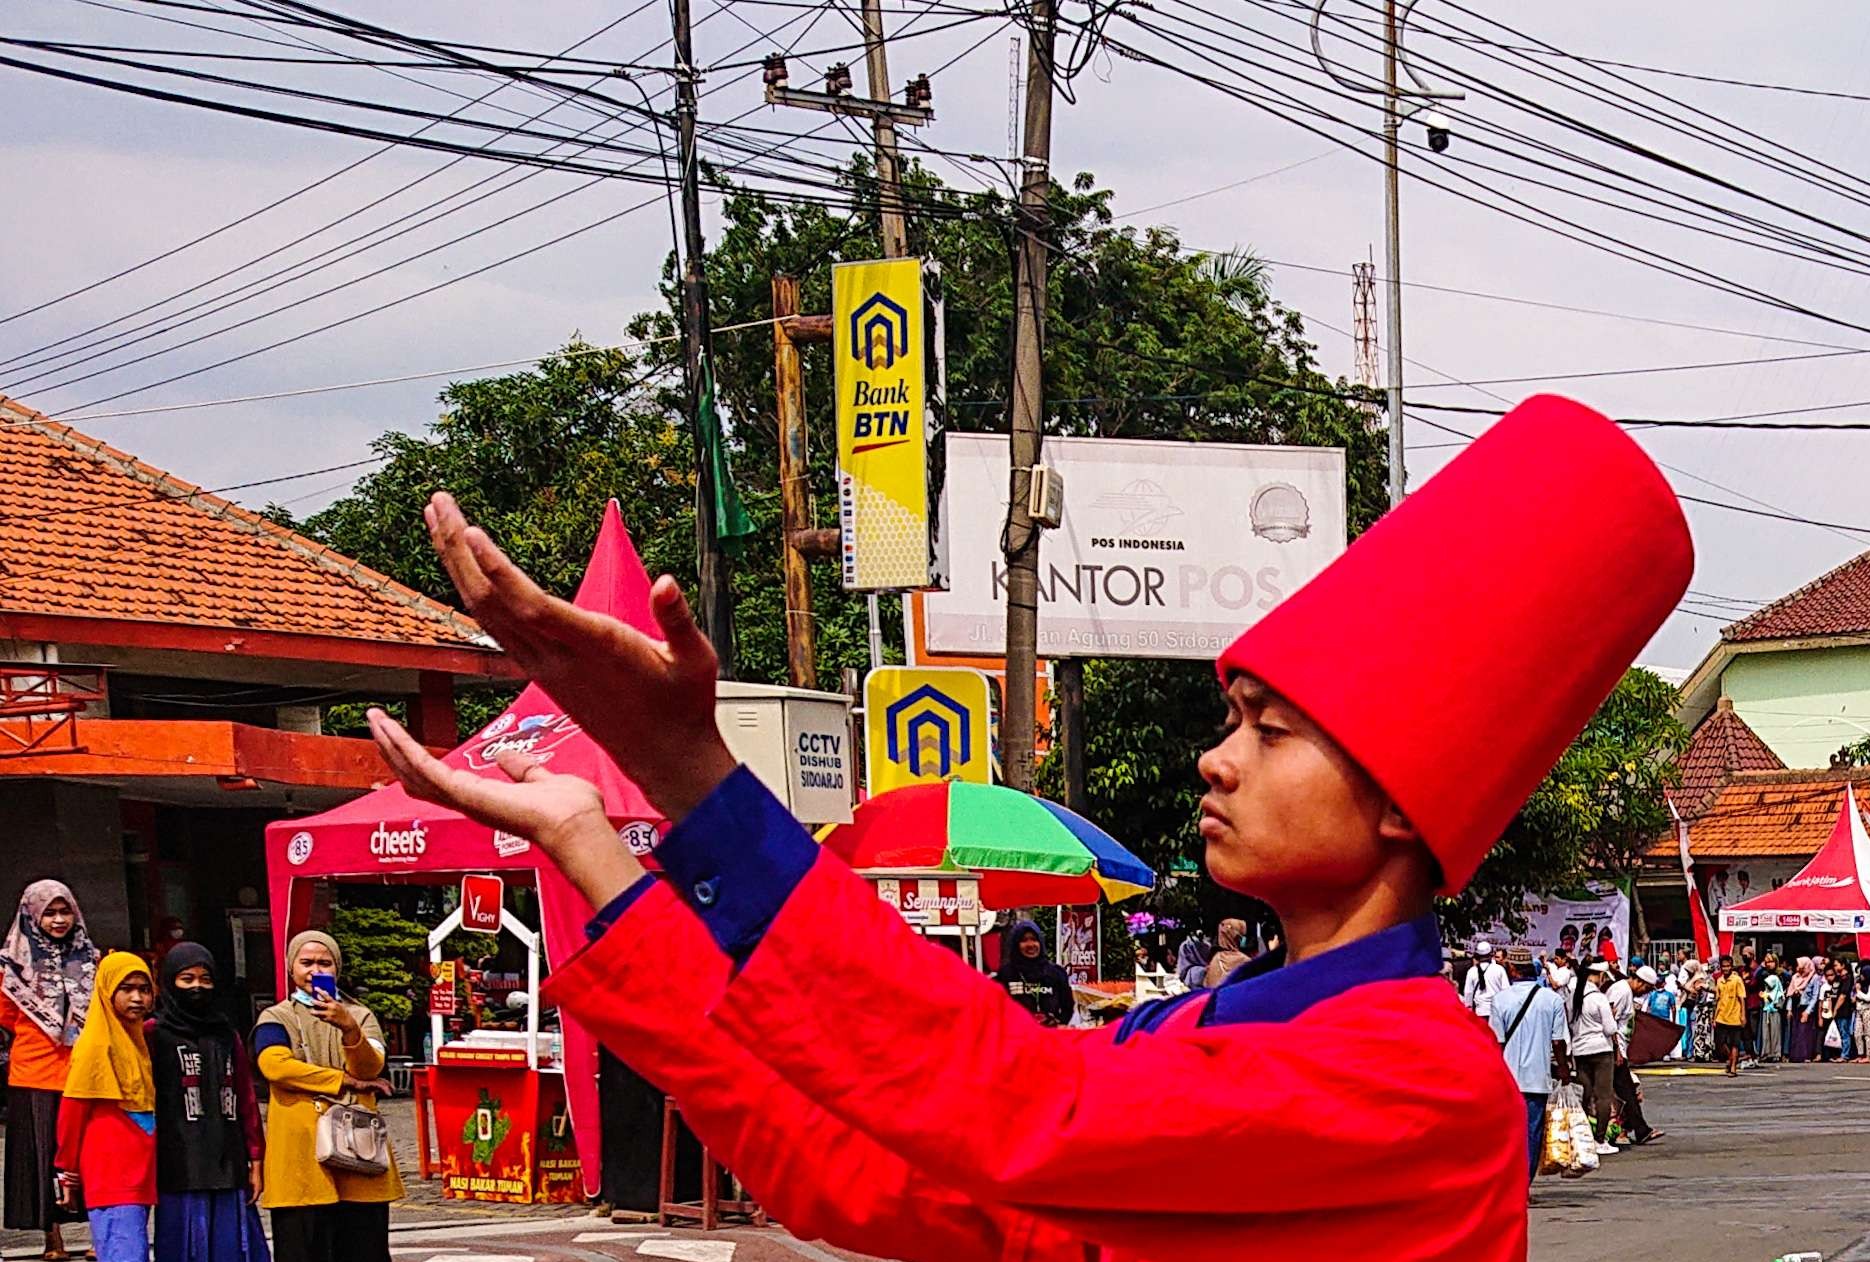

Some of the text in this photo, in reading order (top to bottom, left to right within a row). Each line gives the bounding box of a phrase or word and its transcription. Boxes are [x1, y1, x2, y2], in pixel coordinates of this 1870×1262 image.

[853, 378, 909, 406] Bank
[854, 411, 909, 438] BTN
[1091, 537, 1185, 550] POS INDONESIA
[1178, 564, 1284, 610] POS
[1068, 628, 1130, 648] Agung
[1138, 630, 1159, 646] 50
[799, 732, 841, 755] CCTV
[800, 755, 841, 769] DISHUB
[801, 770, 844, 789] SIDOARJO
[370, 821, 426, 855] cheers
[903, 892, 974, 915] Semangka
[450, 1177, 523, 1194] NASI BAKAR TUMAN
